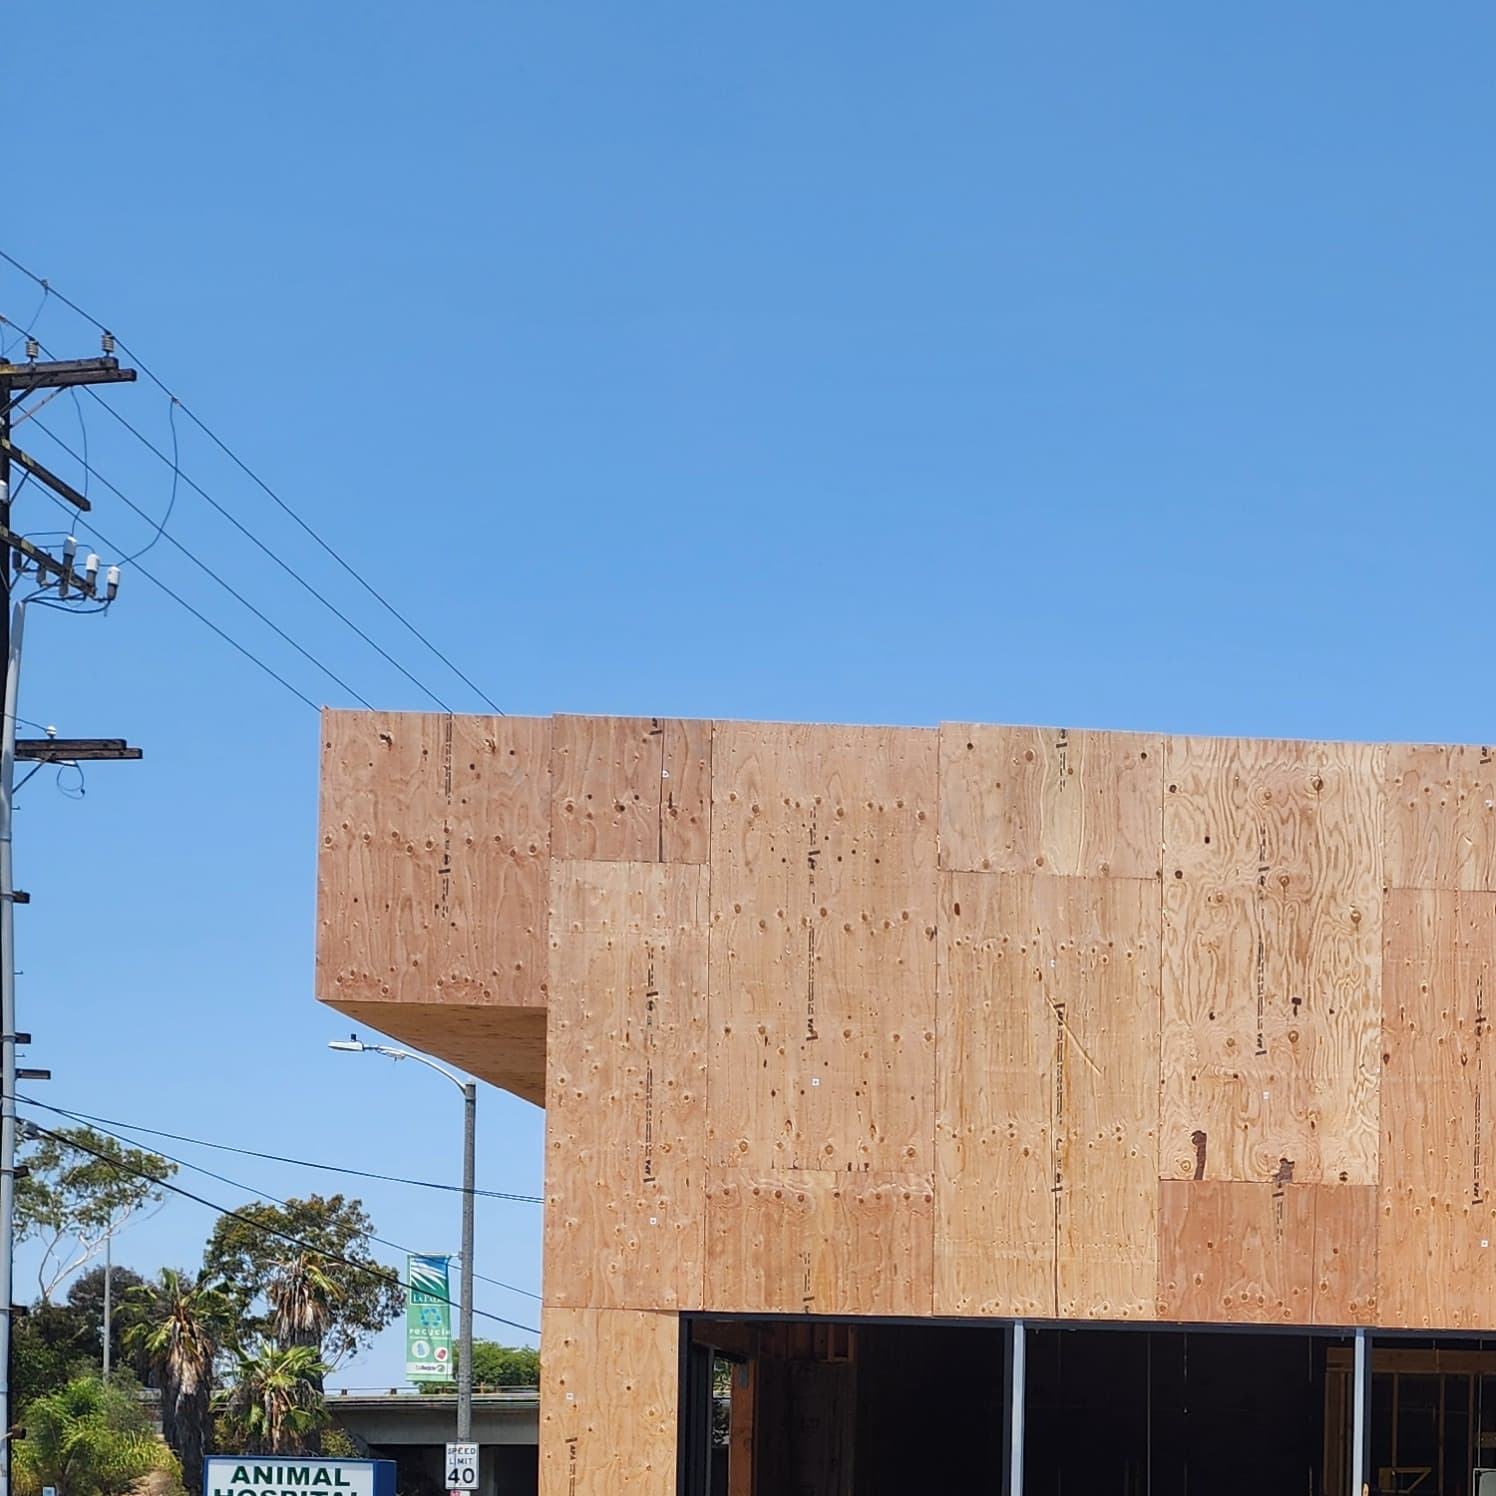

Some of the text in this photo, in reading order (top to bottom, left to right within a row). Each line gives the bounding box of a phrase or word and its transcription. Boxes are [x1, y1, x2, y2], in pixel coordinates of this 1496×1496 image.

[448, 1447, 476, 1455] SPEED
[449, 1457, 473, 1465] LIMIT
[230, 1465, 350, 1487] ANIMAL
[447, 1468, 475, 1484] 40
